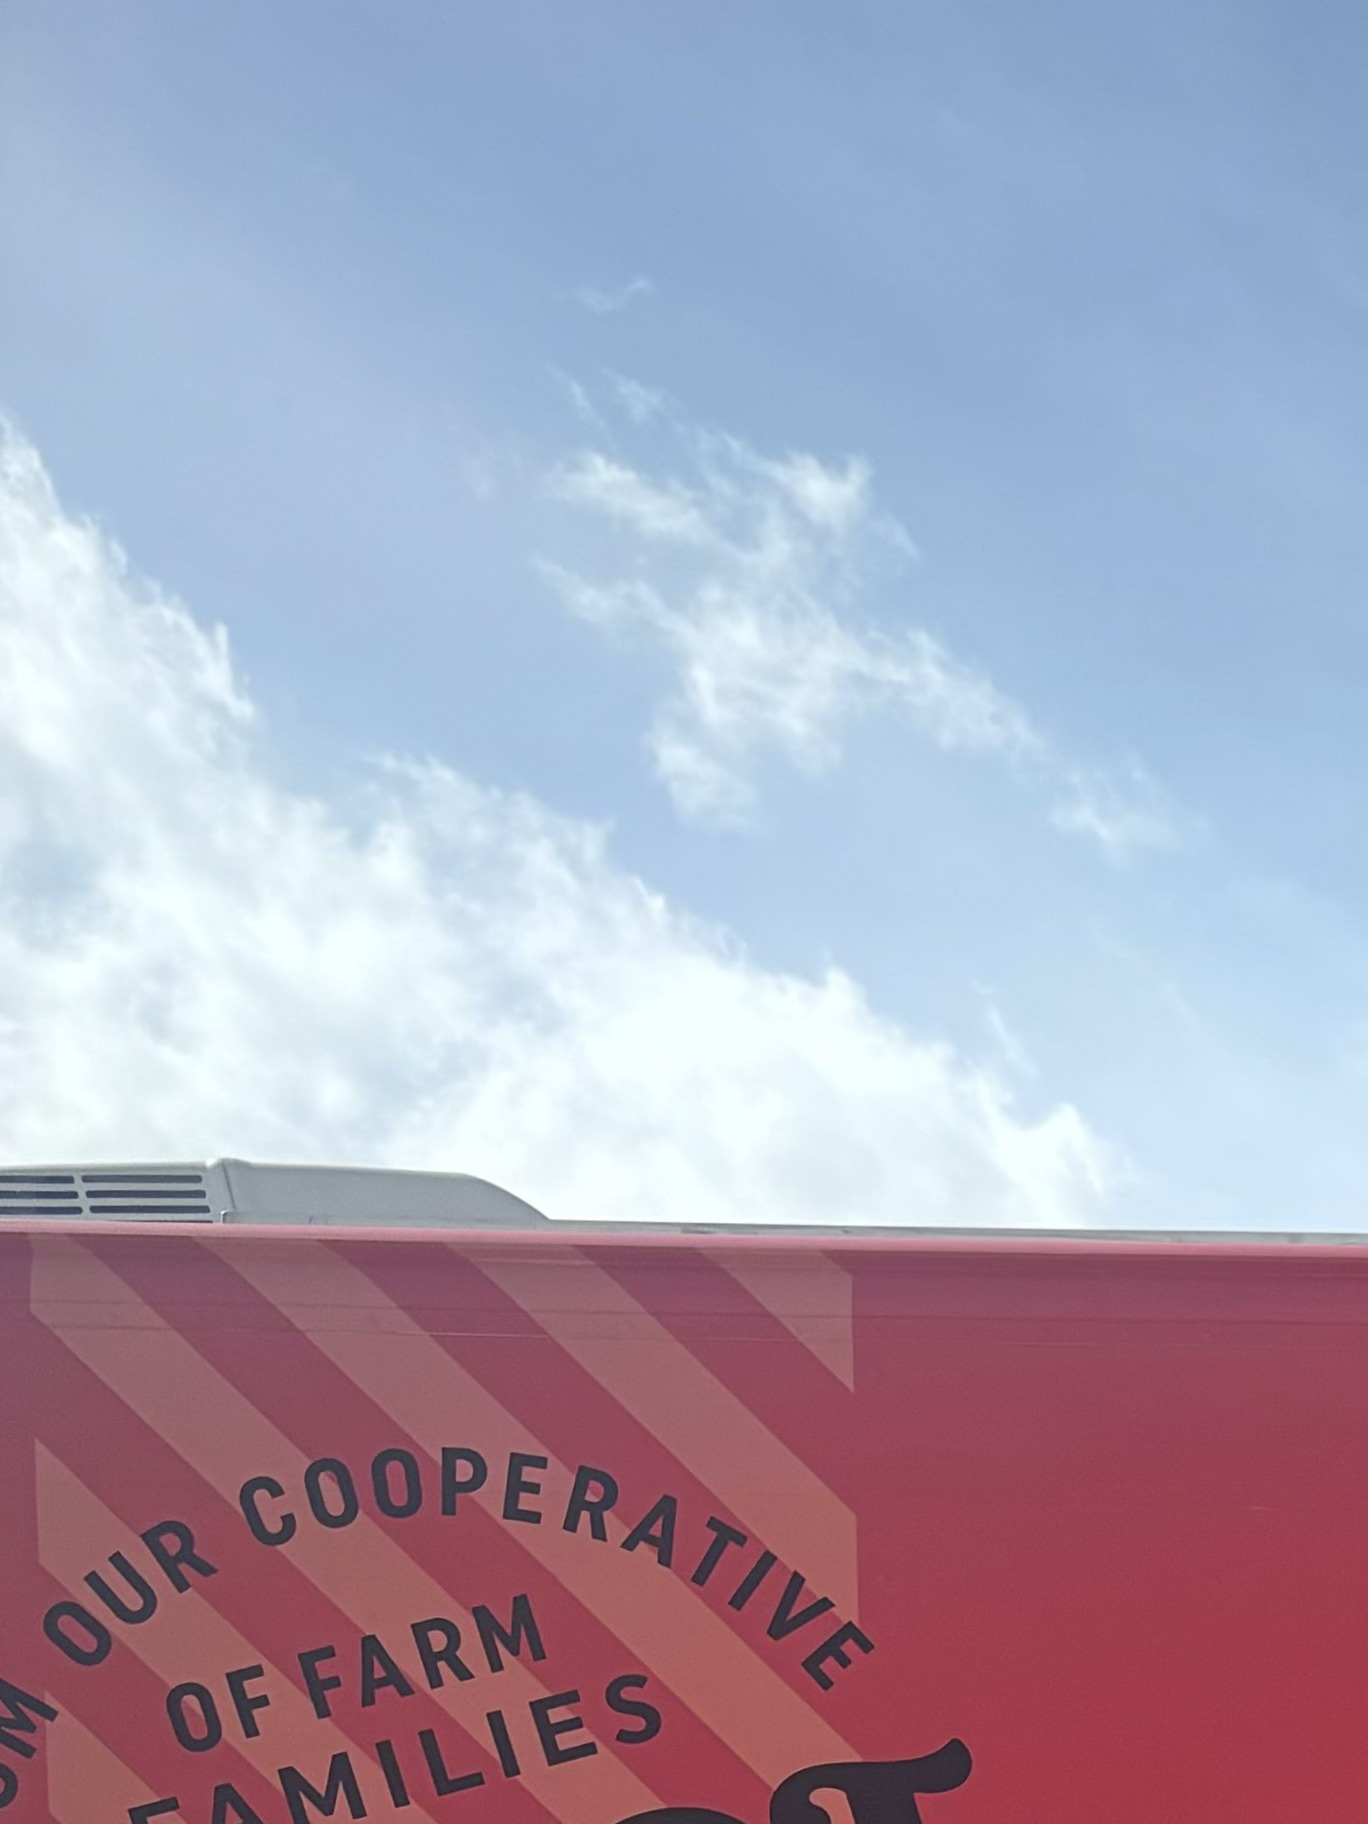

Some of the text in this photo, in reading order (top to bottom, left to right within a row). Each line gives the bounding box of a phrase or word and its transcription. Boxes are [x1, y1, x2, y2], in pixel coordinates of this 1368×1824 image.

[42, 1447, 875, 1692] OUR COOPERATIVE
[166, 1593, 547, 1752] OF FARM
